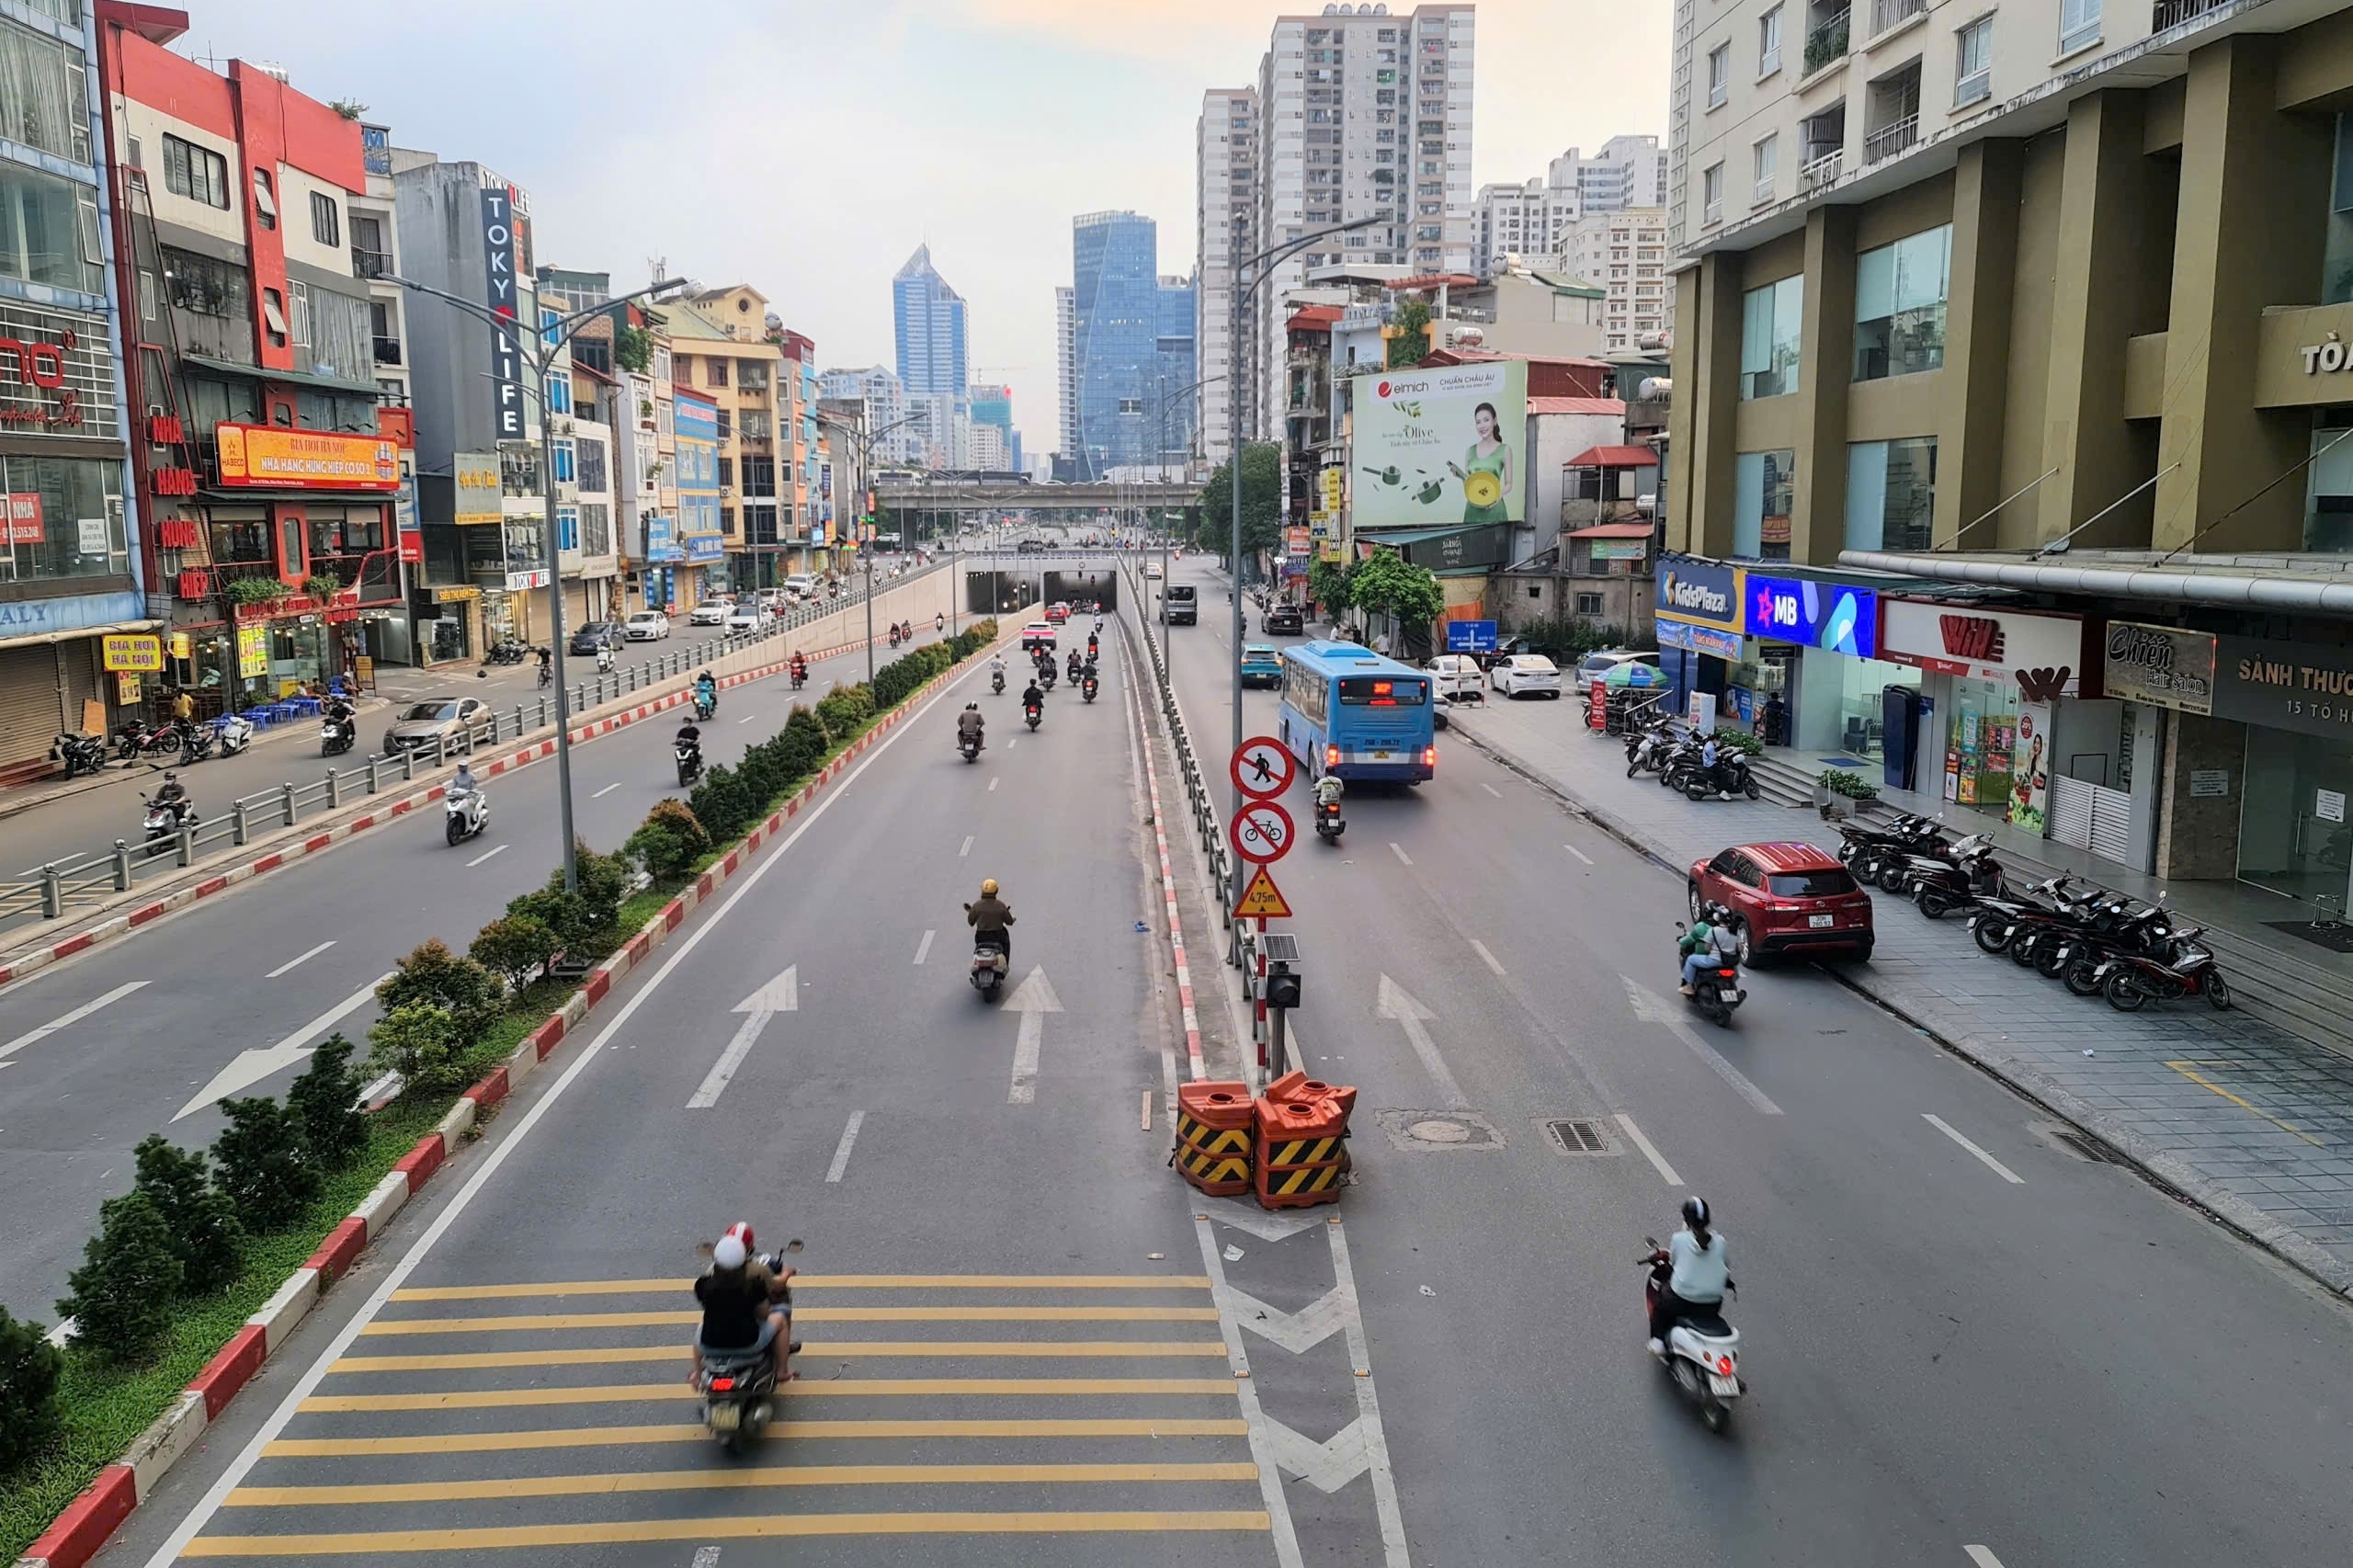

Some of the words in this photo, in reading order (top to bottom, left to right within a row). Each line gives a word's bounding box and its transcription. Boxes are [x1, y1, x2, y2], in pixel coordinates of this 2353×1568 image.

[1393, 381, 1429, 394] elmich
[152, 413, 185, 443] NHÀ
[1404, 426, 1434, 439] Olive
[290, 437, 303, 450] BIA
[222, 458, 244, 467] HABECO
[155, 462, 198, 495] HÀNG
[13, 497, 35, 518] NHÀ
[1675, 581, 1726, 612] KidsPlaza
[1774, 595, 1797, 626] MB
[108, 641, 131, 651] BIA
[2109, 627, 2171, 669] Chiến
[2146, 667, 2170, 687] Hair
[2171, 672, 2205, 694] Salon
[2238, 653, 2293, 687] SẢNH
[2287, 699, 2302, 714] 15
[1250, 892, 1277, 903] 4,75m
